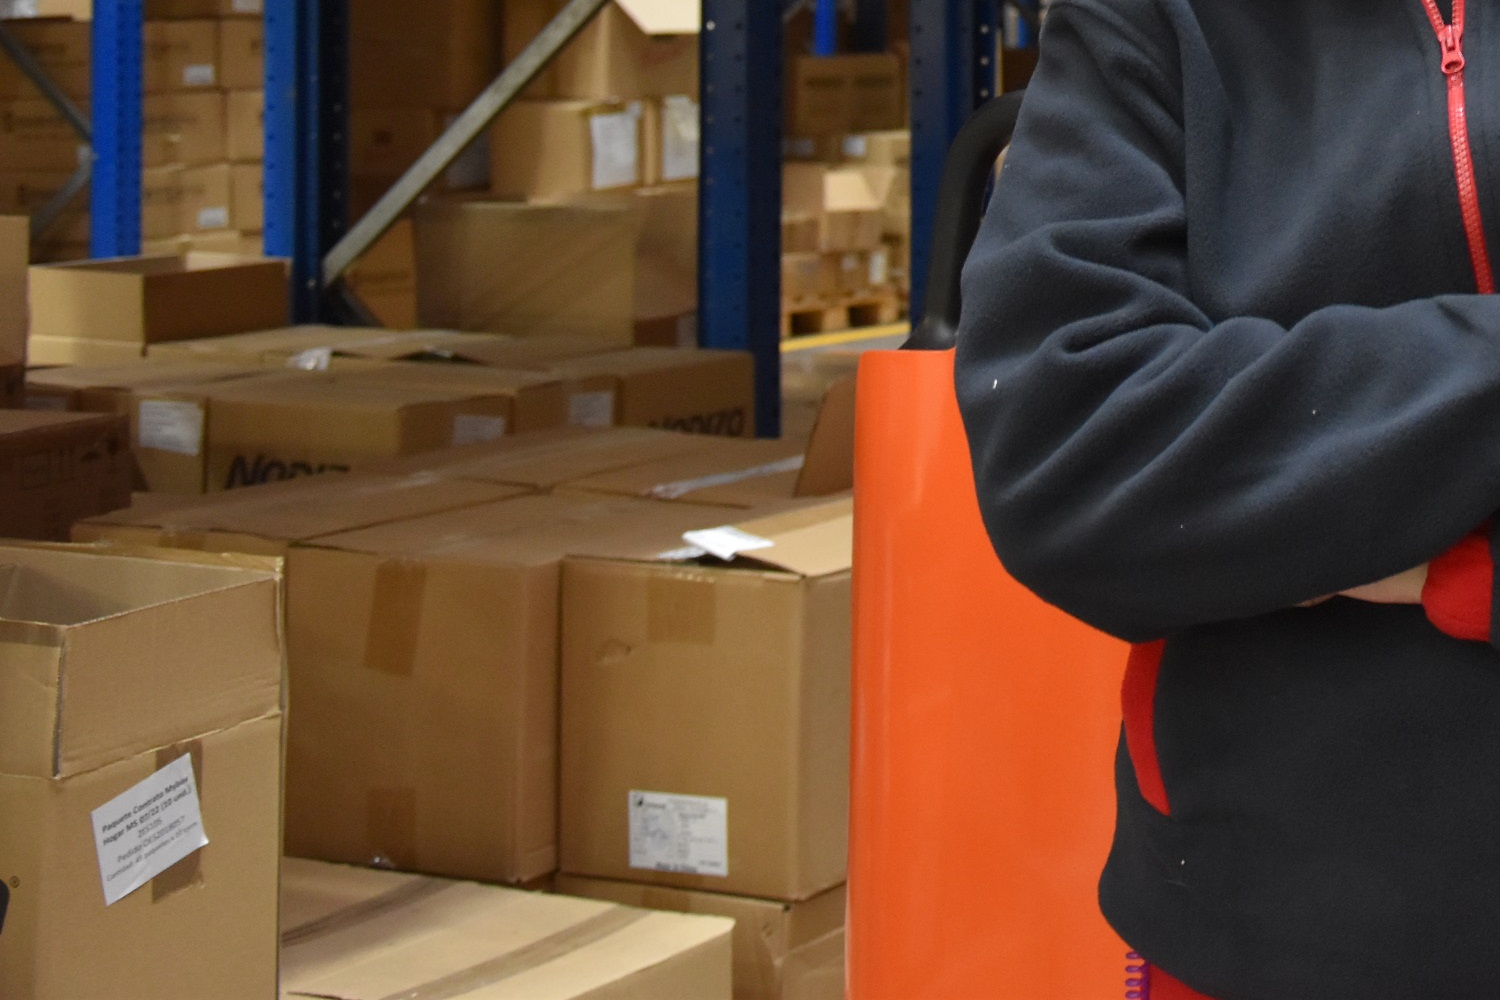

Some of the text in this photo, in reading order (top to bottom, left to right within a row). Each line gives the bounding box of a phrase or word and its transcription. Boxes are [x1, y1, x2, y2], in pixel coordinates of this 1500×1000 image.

[102, 811, 132, 833] Paquete
[133, 791, 164, 815] Contrato
[103, 829, 125, 846] Hogar
